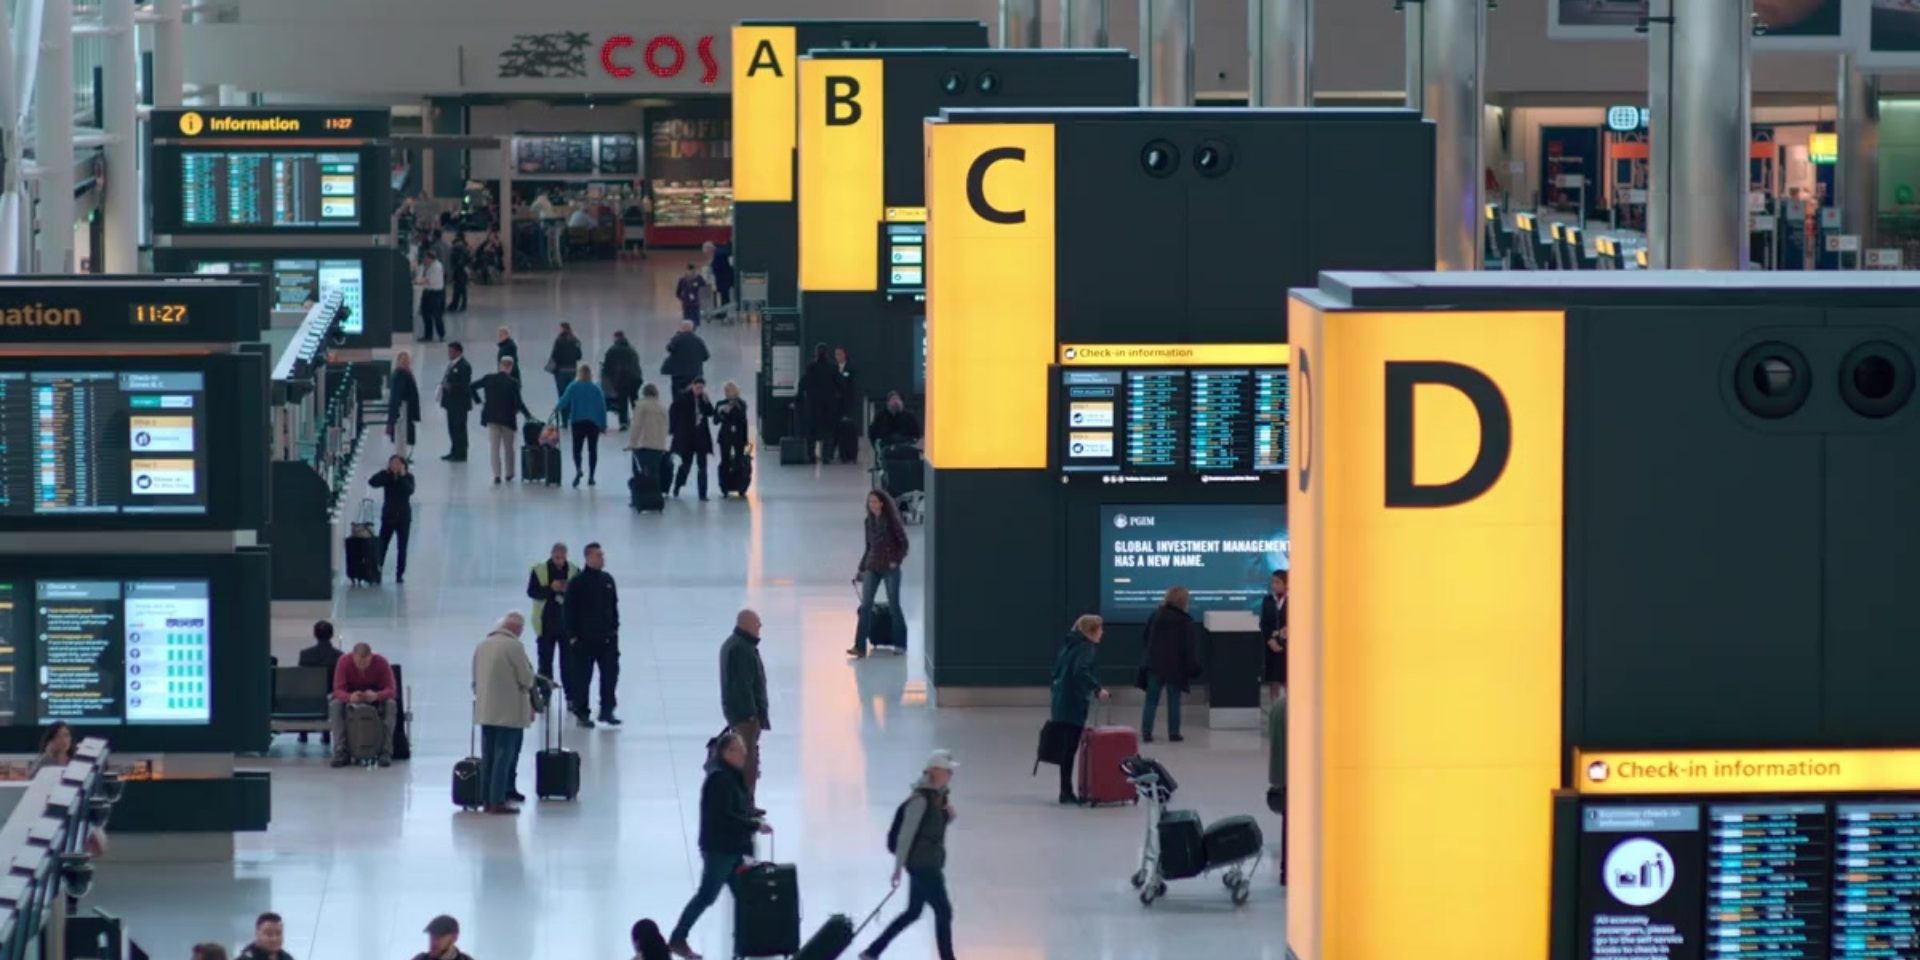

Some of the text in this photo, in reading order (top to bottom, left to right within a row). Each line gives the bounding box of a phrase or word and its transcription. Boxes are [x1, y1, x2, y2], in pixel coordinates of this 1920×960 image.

[746, 40, 784, 77] A
[825, 75, 862, 126] B
[210, 117, 300, 131] Information
[966, 147, 1026, 224] C
[136, 305, 187, 322] 11:27
[1079, 348, 1193, 358] Check-in information
[1384, 360, 1513, 508] D
[1130, 516, 1155, 527] PGIM
[1114, 540, 1154, 553] GLOBAL
[1157, 540, 1219, 553] INVESTMENT
[1114, 554, 1205, 567] HAS A NEW NAME.
[1617, 759, 1841, 778] Check-in information
